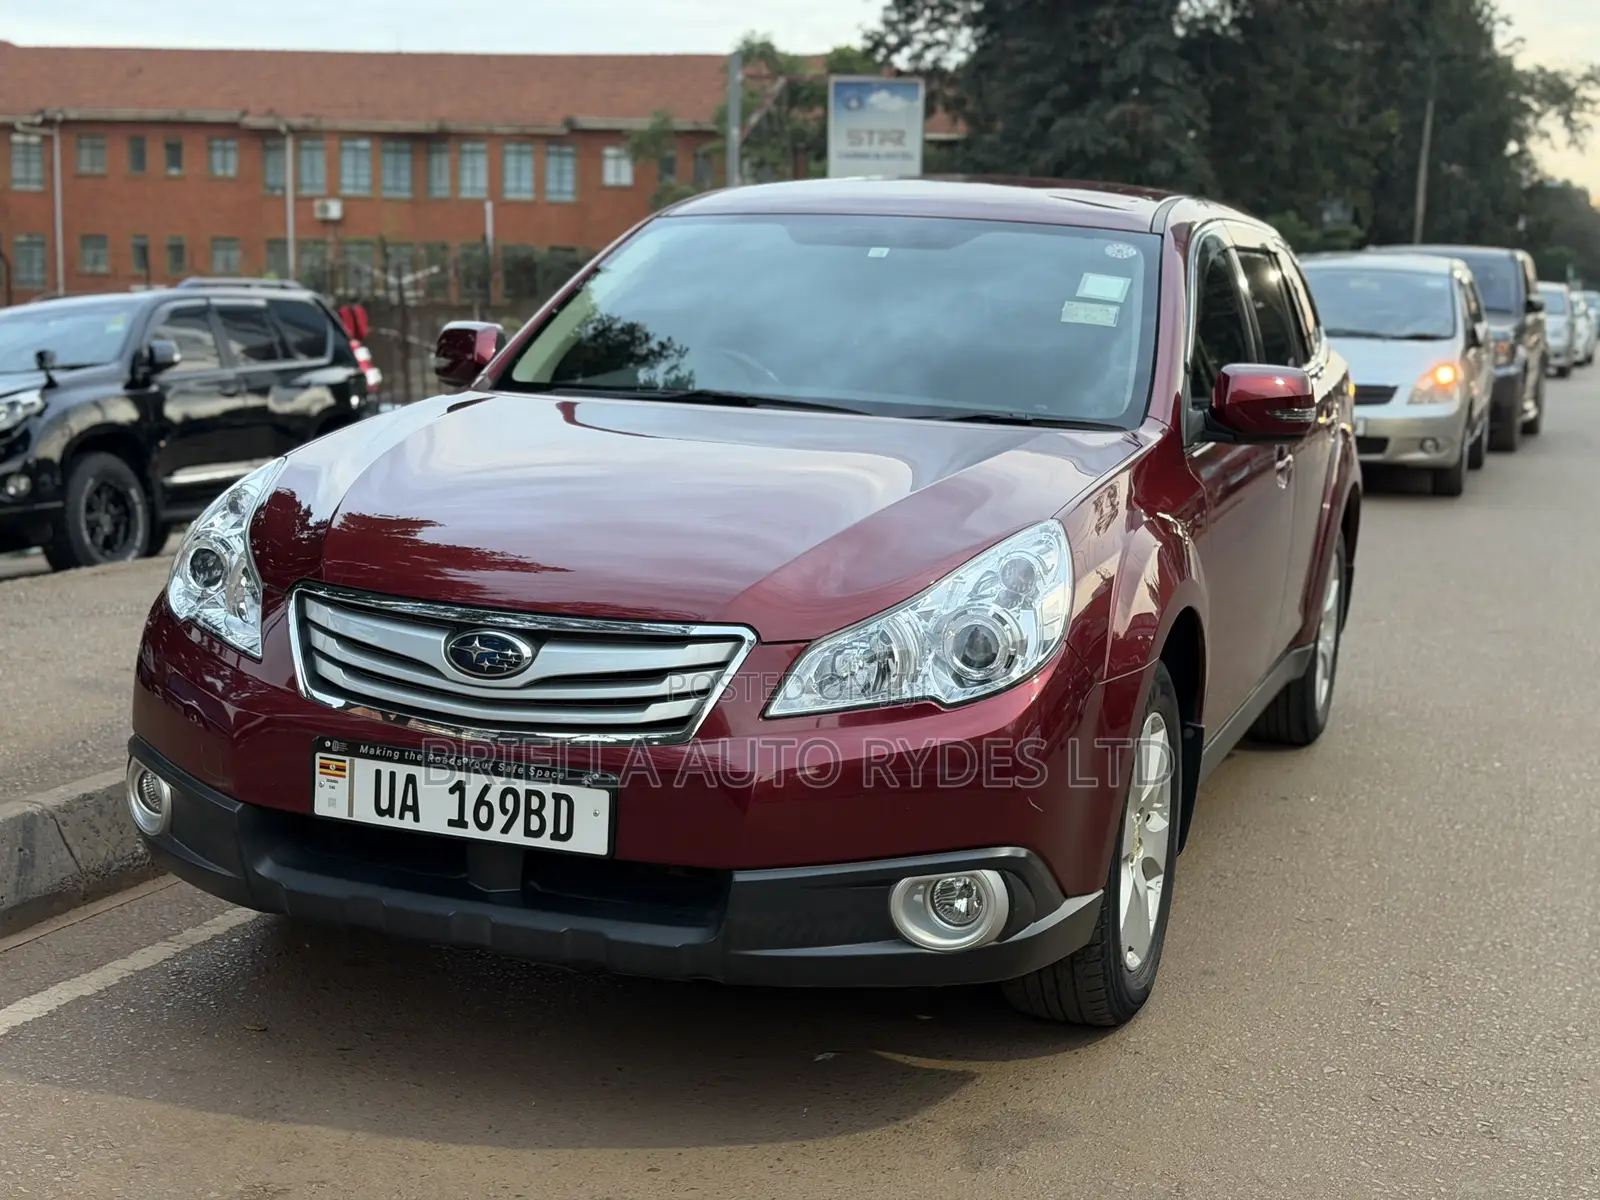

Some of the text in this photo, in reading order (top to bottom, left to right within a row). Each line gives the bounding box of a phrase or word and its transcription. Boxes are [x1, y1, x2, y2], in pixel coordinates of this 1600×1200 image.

[359, 744, 400, 760] Making
[404, 751, 423, 761] the
[427, 753, 462, 766] Roads
[468, 756, 493, 770] Your
[497, 762, 524, 775] Safe
[528, 766, 565, 780] Space
[374, 768, 575, 842] UA 169BD
